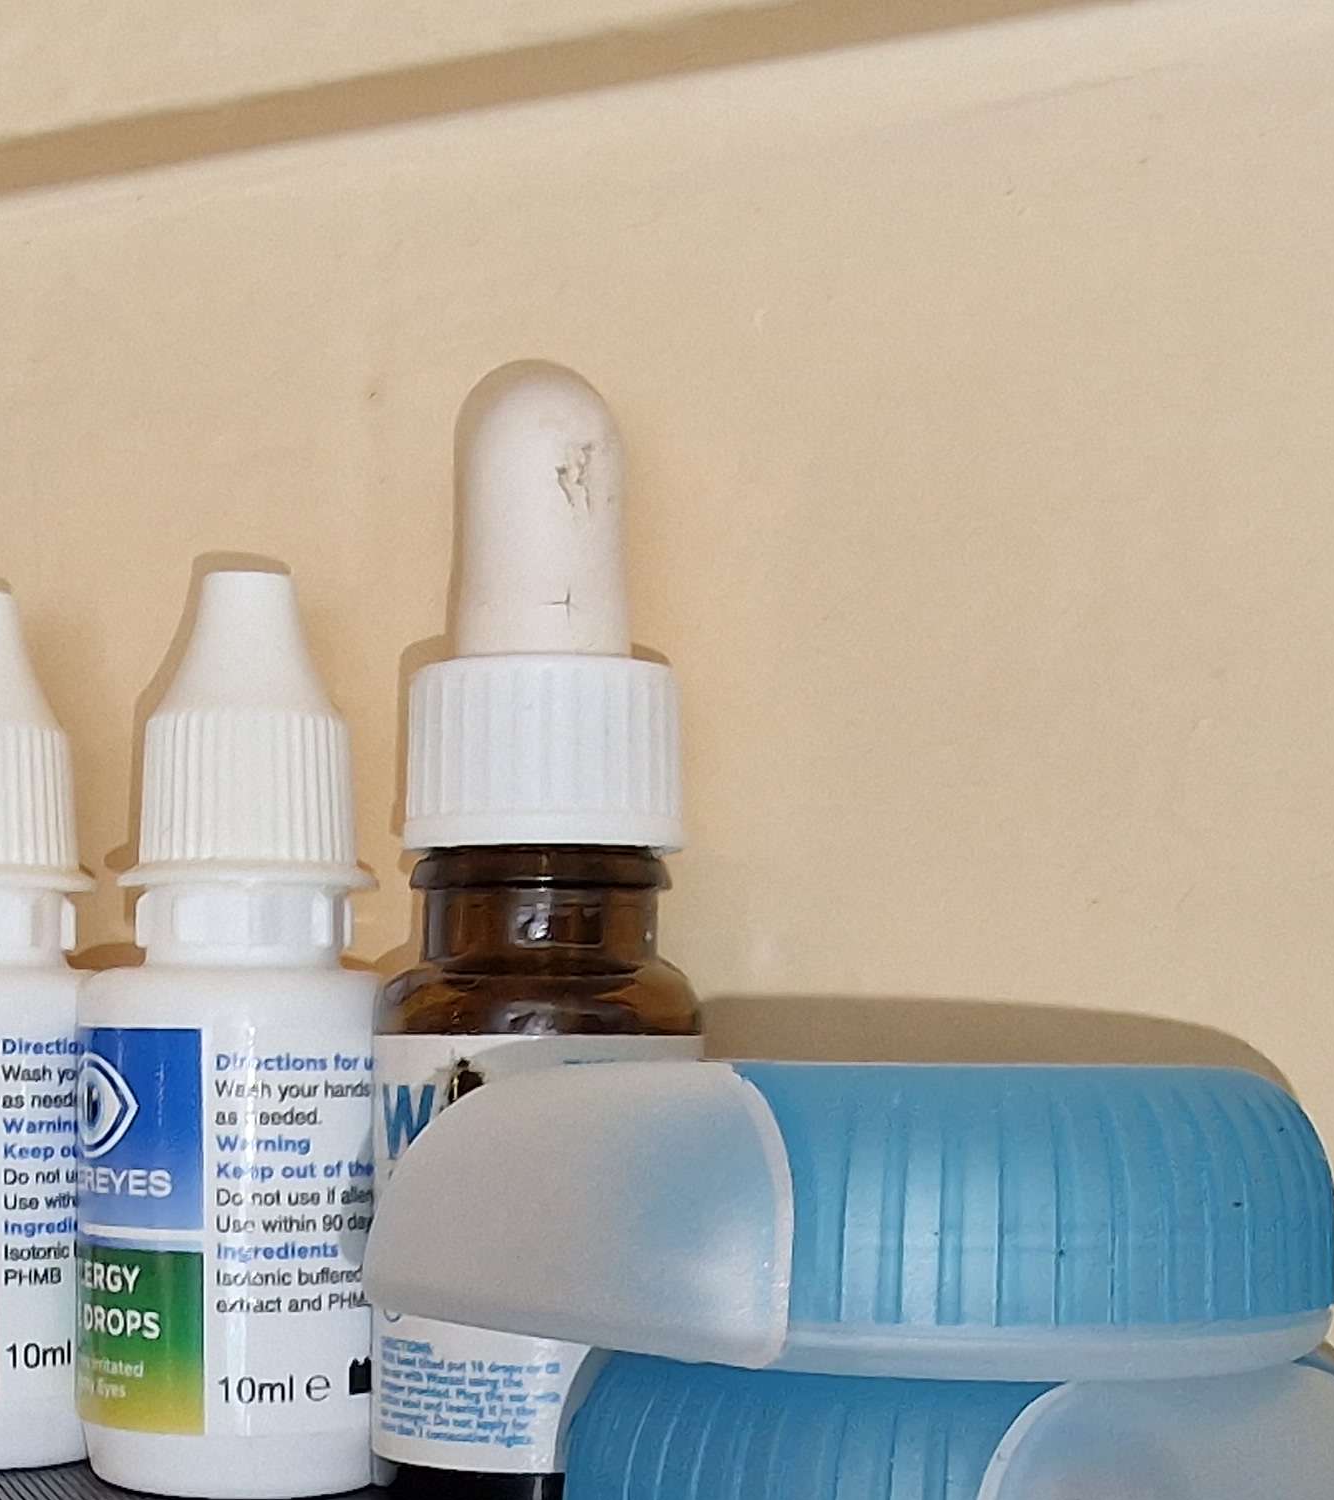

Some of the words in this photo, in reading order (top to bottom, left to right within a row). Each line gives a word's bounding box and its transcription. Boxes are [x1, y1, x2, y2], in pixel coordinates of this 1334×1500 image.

[333, 1053, 361, 1072] for
[1, 1064, 52, 1083] Wash
[2, 1093, 25, 1109] as
[277, 1084, 320, 1103] your
[243, 1107, 324, 1127] eeded.
[3, 1144, 55, 1163] Keep
[4, 1168, 30, 1186] Do
[35, 1167, 61, 1185] not
[280, 1163, 318, 1180] out
[322, 1160, 343, 1178] of
[348, 1160, 375, 1178] the
[4, 1193, 39, 1211] Use
[216, 1187, 243, 1207] Do
[251, 1189, 281, 1206] not
[287, 1191, 320, 1206] use
[326, 1186, 336, 1205] if
[216, 1215, 256, 1234] Use
[261, 1213, 317, 1233] within
[322, 1214, 343, 1231] 90
[4, 1242, 70, 1261] Isotonic
[217, 1242, 339, 1263] Ingredients
[4, 1271, 63, 1288] PHMB
[287, 1294, 323, 1312] and
[83, 1302, 161, 1340] DROPS
[6, 1339, 72, 1369] 10ml
[218, 1374, 294, 1404] 10ml
